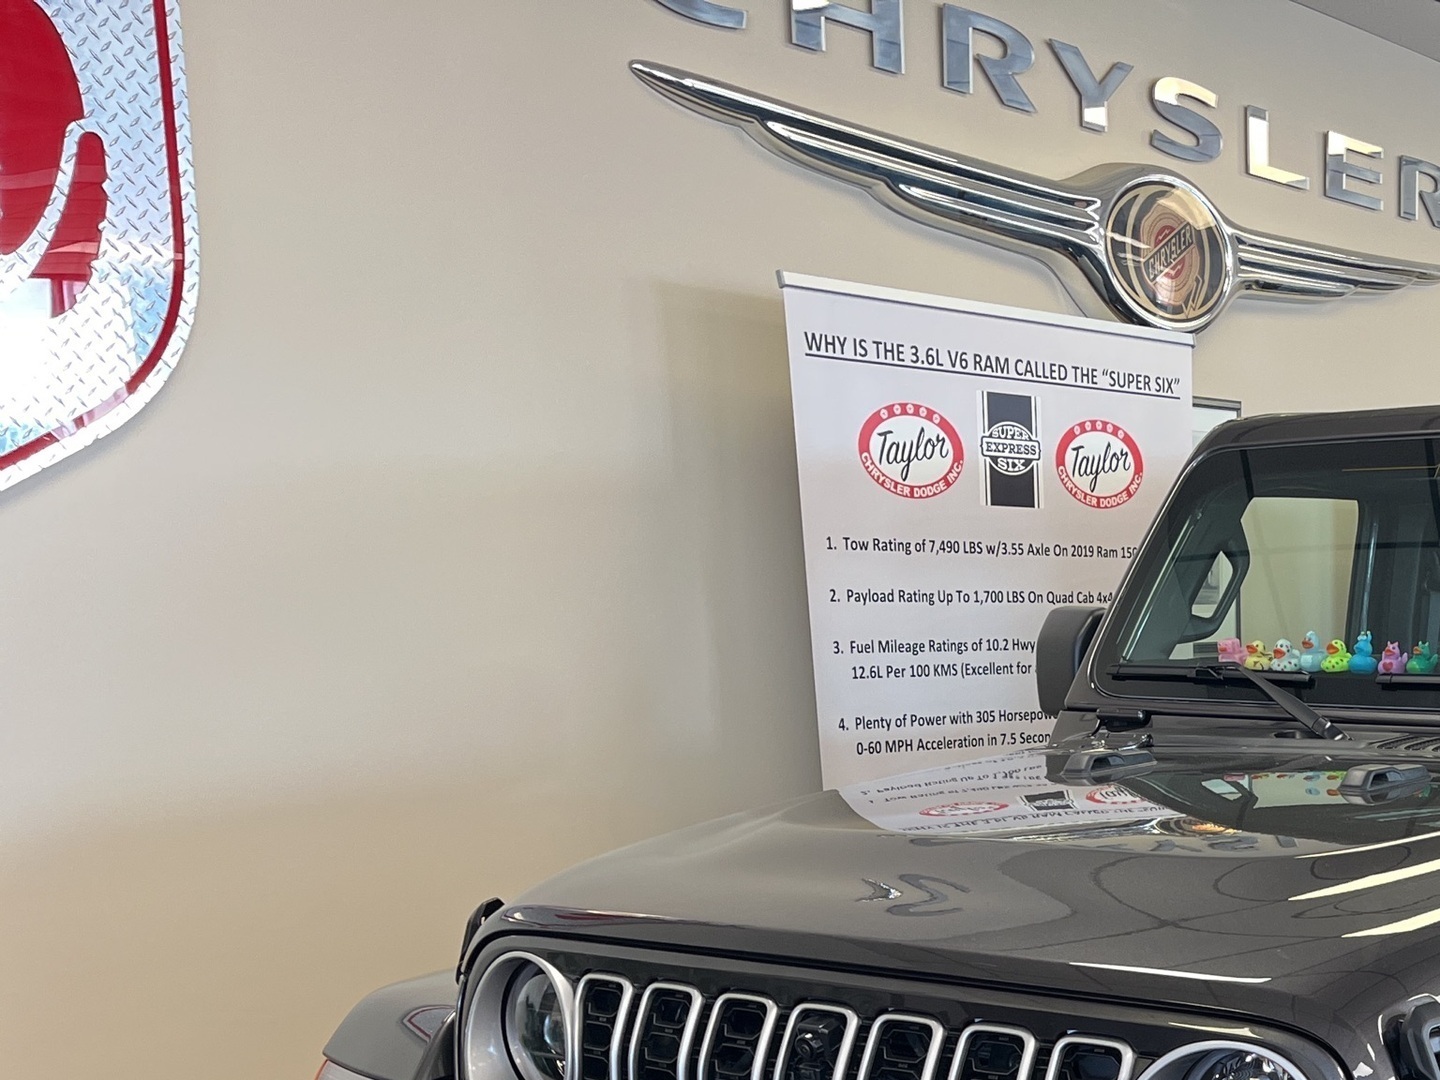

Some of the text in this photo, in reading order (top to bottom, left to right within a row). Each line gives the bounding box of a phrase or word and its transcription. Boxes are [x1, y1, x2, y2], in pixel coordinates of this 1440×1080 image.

[1149, 225, 1192, 280] CHRYSLER
[804, 332, 847, 354] WHY
[854, 338, 867, 357] IS
[873, 341, 905, 362] THE
[911, 346, 943, 366] 3.6L
[948, 350, 968, 369] V6
[974, 354, 1009, 374] RAM
[1015, 359, 1067, 380] CALLED
[1072, 366, 1097, 384] THE
[992, 426, 1030, 440] SUPER
[877, 426, 949, 482] Taylor
[985, 441, 1037, 455] EXPRESS
[861, 452, 963, 498] CHRYSLER DODGE INC.
[997, 458, 1026, 472] SIX
[1071, 441, 1131, 493] Taylor
[1058, 466, 1143, 508] CHRYSLER DODGE INC.
[826, 536, 837, 550] 1.
[843, 537, 868, 550] Tow
[873, 538, 911, 555] Rating
[915, 539, 925, 552] of
[929, 540, 959, 554] 7,490
[964, 541, 982, 554] LBS
[986, 541, 1023, 557] w/3.55
[1027, 544, 1050, 556] Axle
[1054, 544, 1067, 556] On
[1071, 545, 1094, 557] 2019
[1097, 546, 1117, 558] Ram
[830, 589, 1113, 605] 2. Payload Rating Up To 1,700 LBS On Quad Cab 4x4
[834, 638, 1035, 655] 3. Fuel Mileage Ratings of 10.2 Hwy
[852, 662, 1031, 679] 12.6L Per 100 KMS (Excellent for
[839, 718, 848, 730] 4.
[856, 716, 891, 731] Plenty
[895, 714, 907, 727] of
[911, 714, 946, 727] Power
[950, 711, 973, 725] with
[977, 711, 995, 723] 305
[857, 741, 881, 755] 0-60
[885, 739, 913, 753] MPH
[917, 735, 984, 751] Acceleration
[988, 734, 997, 745] in
[1000, 733, 1016, 745] 7.5
